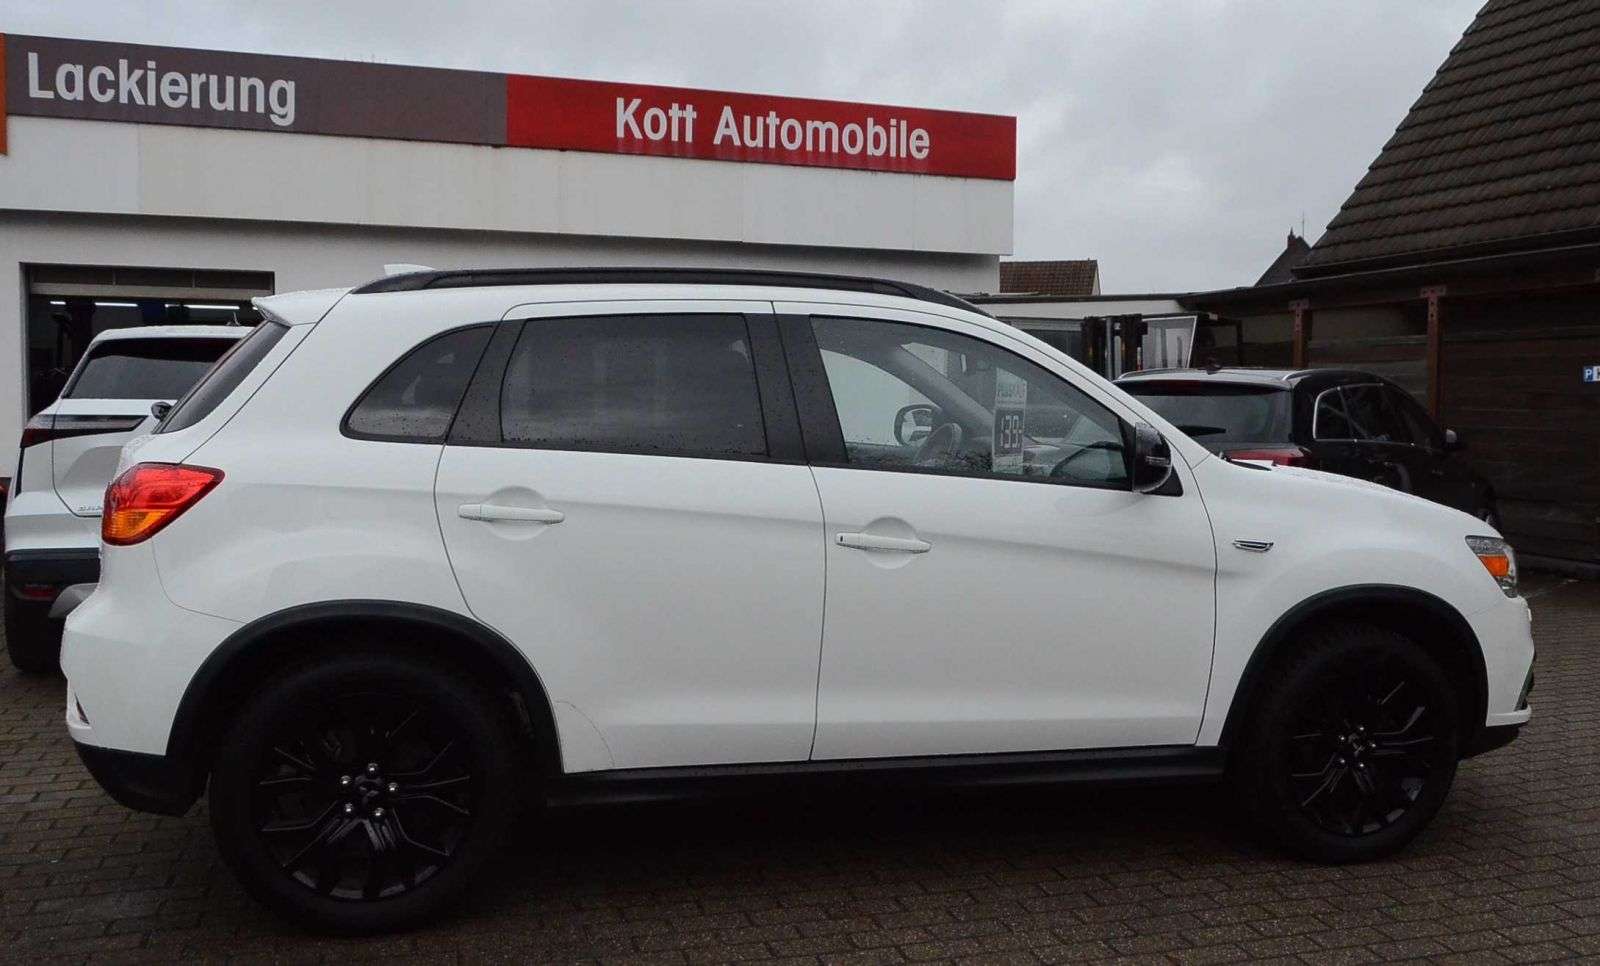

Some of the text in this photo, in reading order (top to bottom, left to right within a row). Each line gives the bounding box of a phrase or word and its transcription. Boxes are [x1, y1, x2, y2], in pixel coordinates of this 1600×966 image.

[27, 52, 296, 127] Lackierung
[615, 97, 931, 160] Kott Automobile
